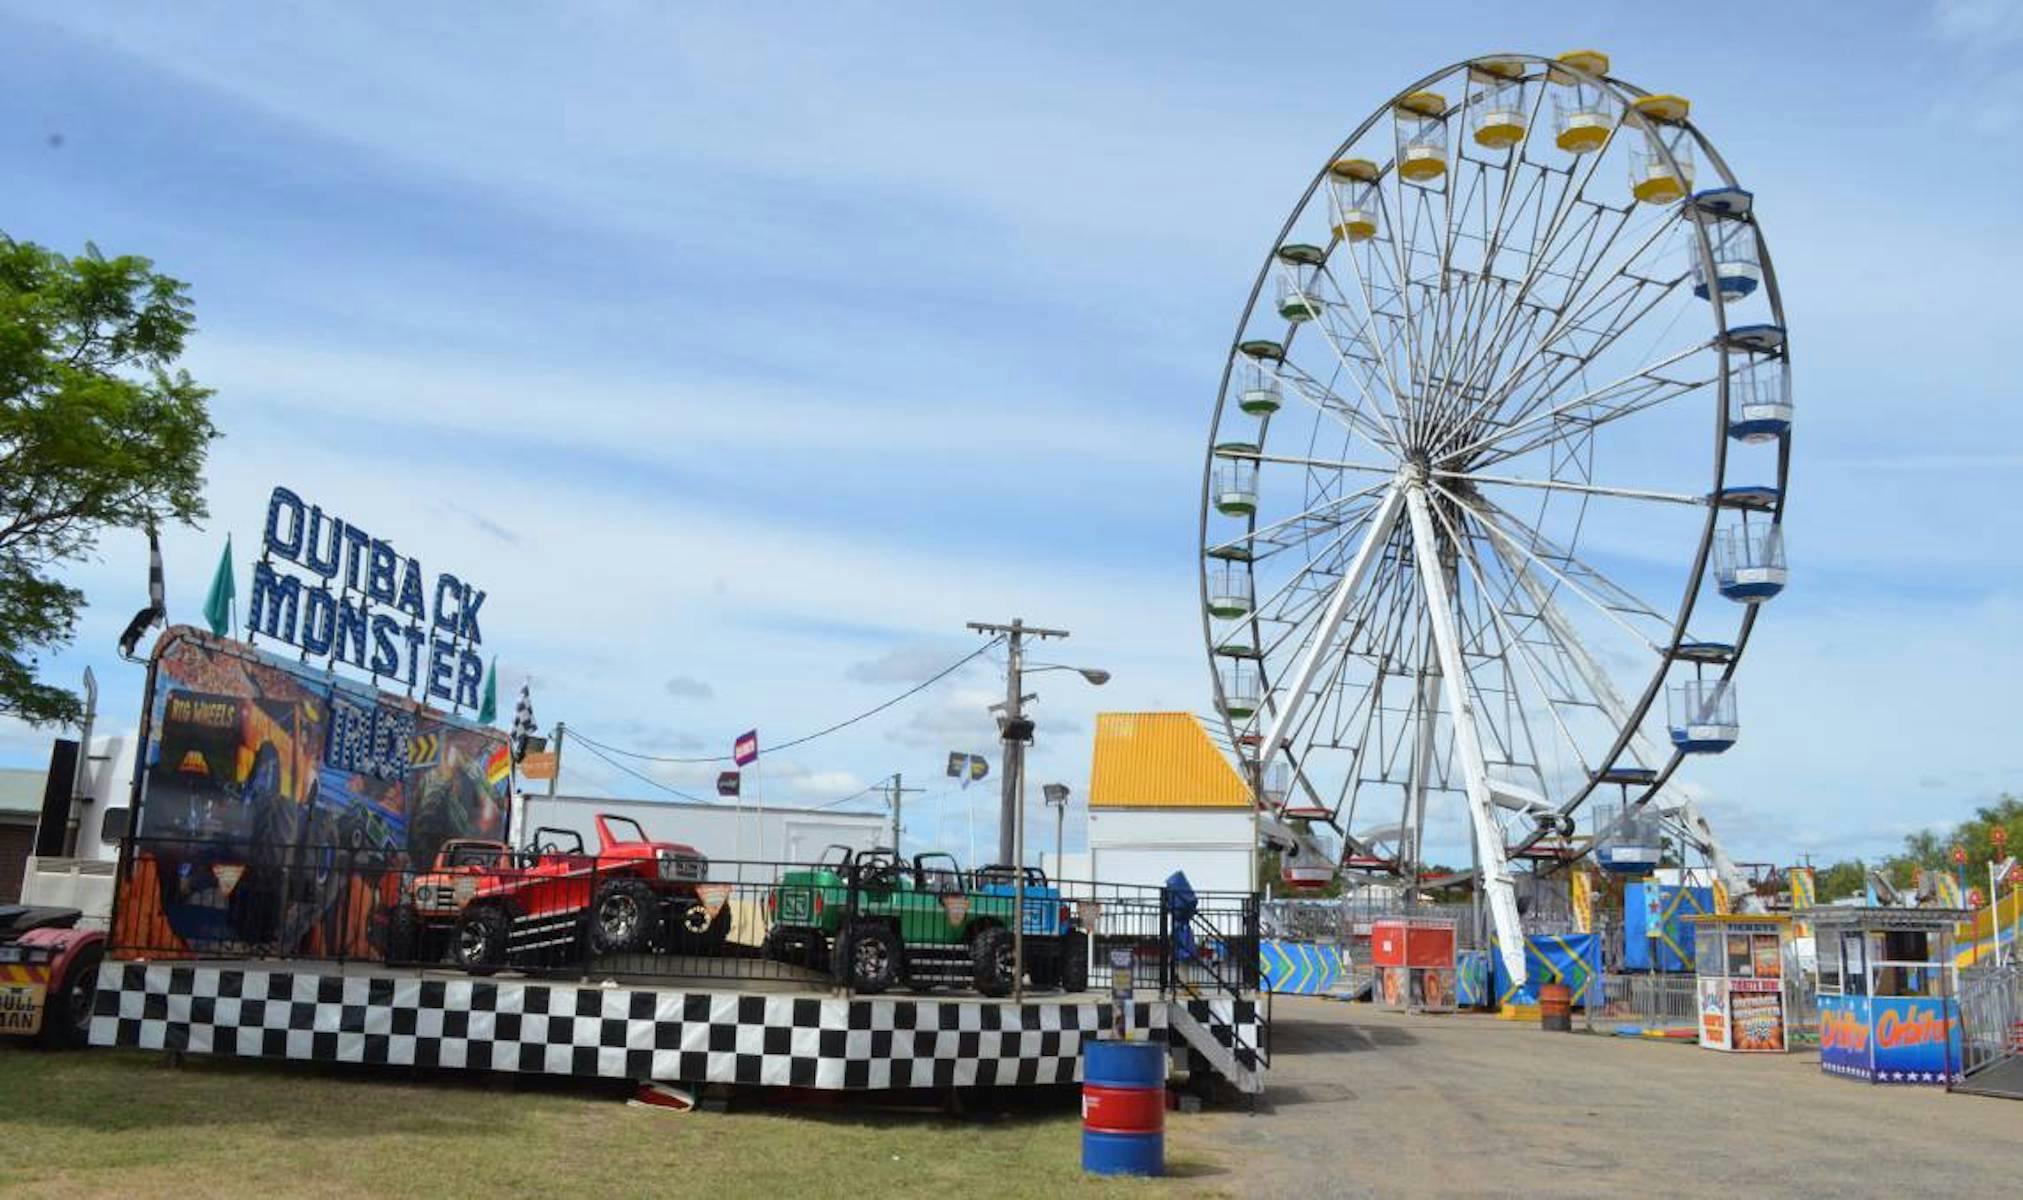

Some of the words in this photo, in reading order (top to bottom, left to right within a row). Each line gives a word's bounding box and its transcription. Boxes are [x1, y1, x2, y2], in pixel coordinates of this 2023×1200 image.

[265, 486, 486, 645] OUTBACK
[249, 560, 484, 710] MONSTER
[192, 700, 235, 728] WHEELS
[0, 995, 35, 1011] ULL
